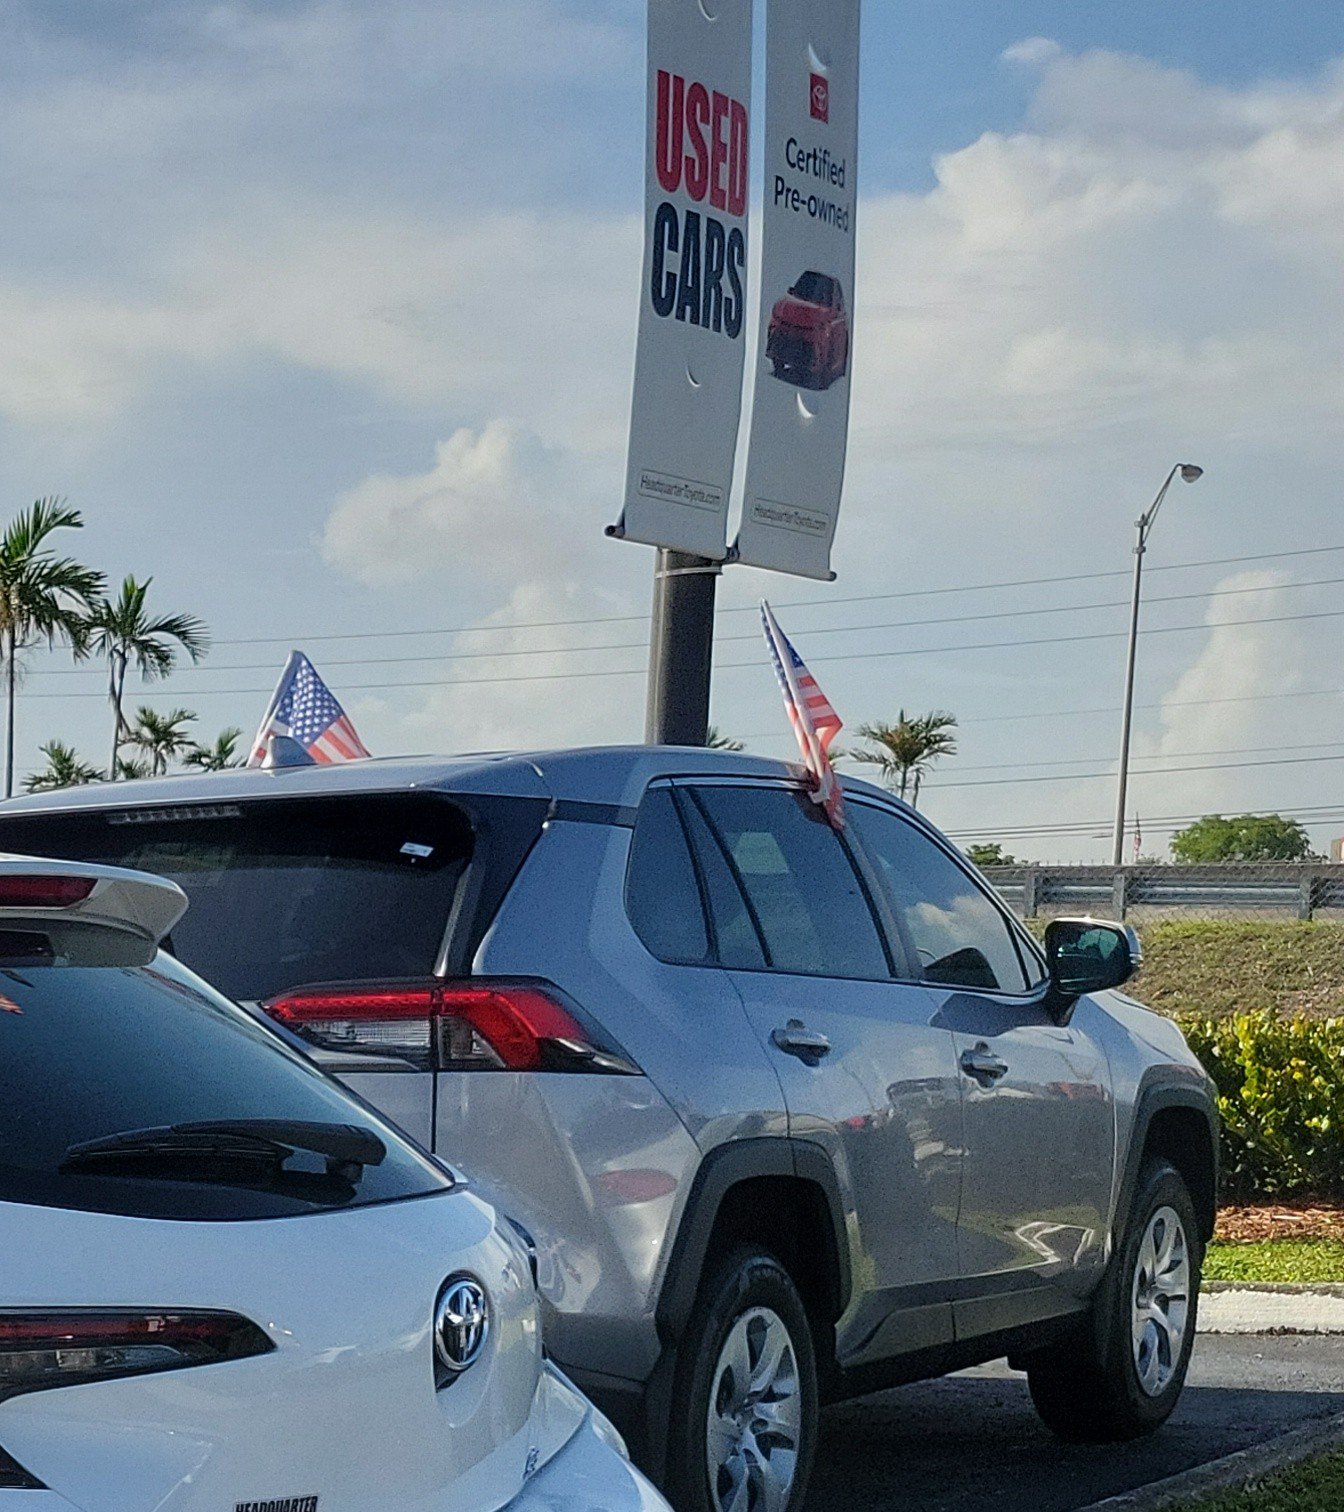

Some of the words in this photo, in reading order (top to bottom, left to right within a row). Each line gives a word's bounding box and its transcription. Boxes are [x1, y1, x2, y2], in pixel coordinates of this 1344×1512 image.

[656, 69, 748, 217] USED
[786, 138, 846, 188] Certified
[774, 175, 849, 233] Pre-owned
[651, 202, 745, 340] CARS
